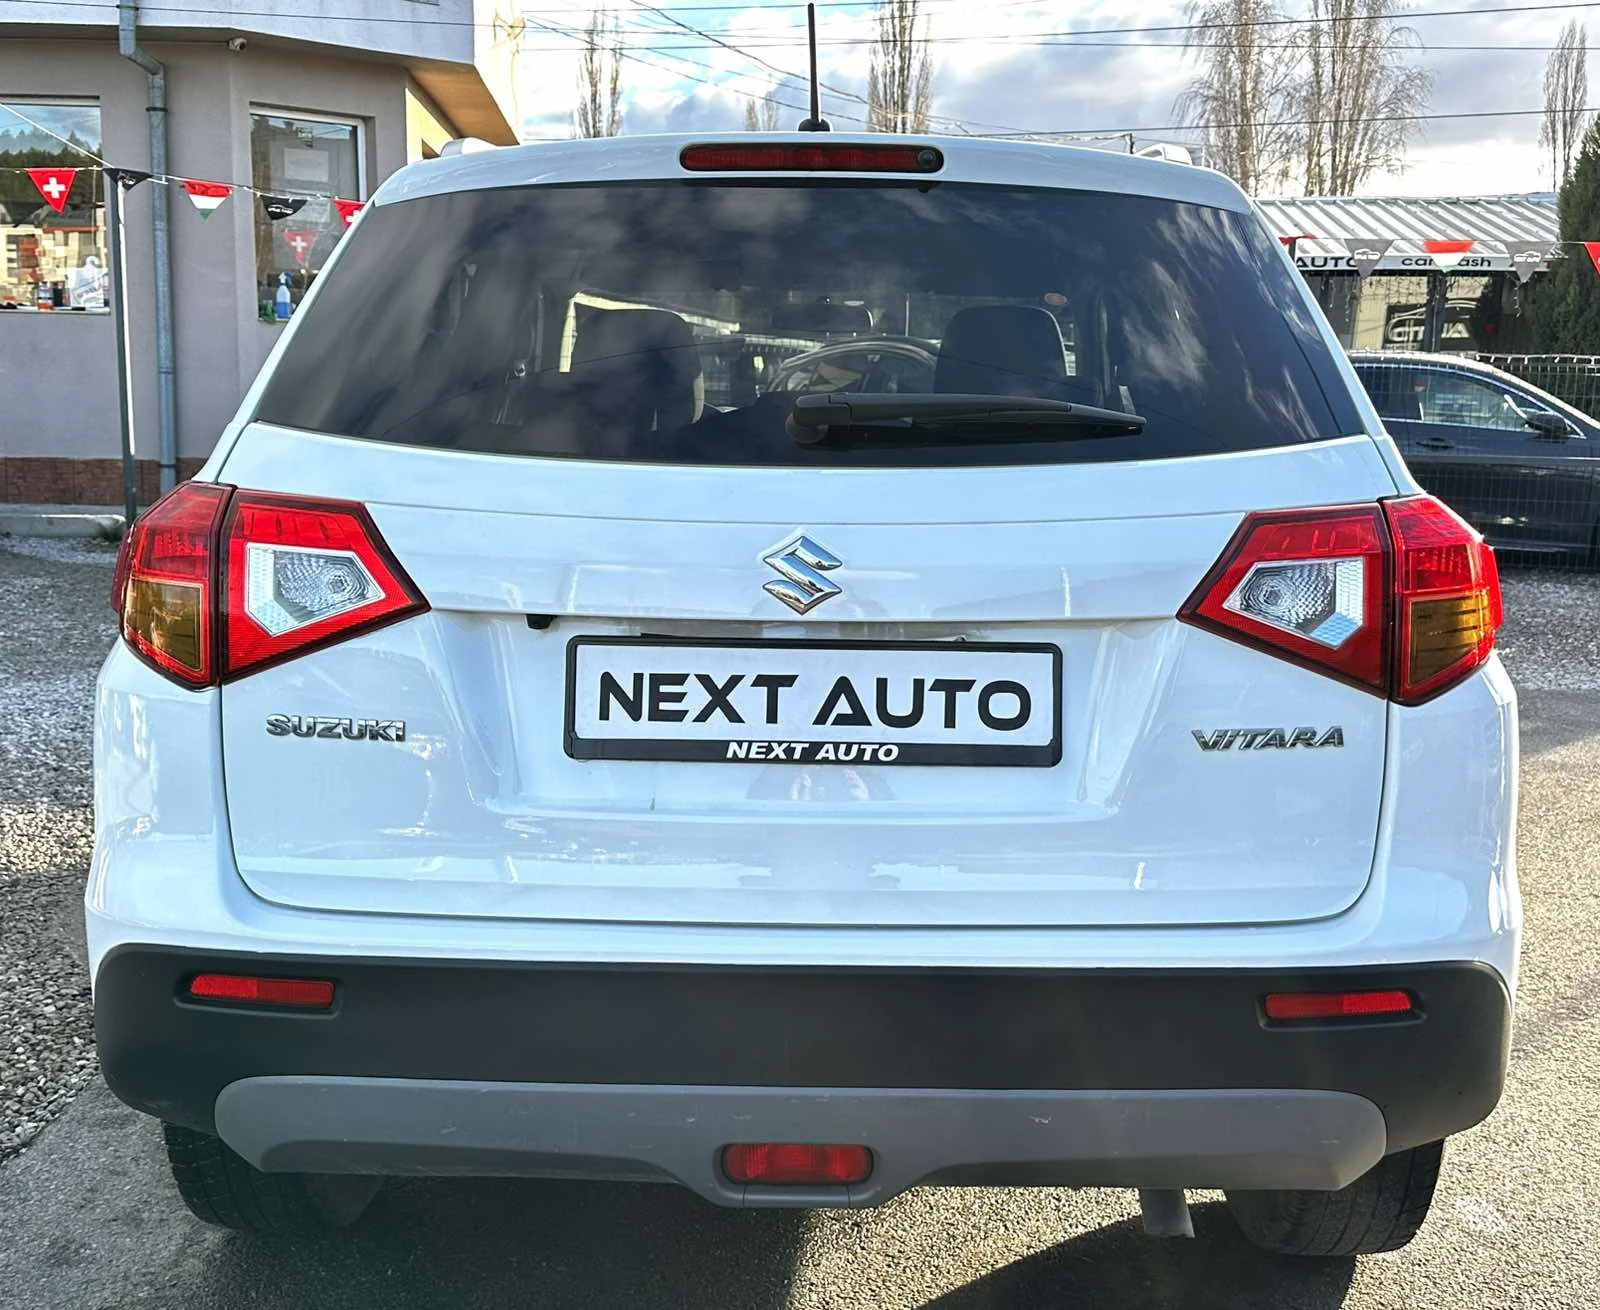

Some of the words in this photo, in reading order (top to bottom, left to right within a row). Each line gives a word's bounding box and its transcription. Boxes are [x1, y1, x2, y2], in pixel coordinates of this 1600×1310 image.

[599, 671, 799, 724] NEXT
[812, 676, 1031, 731] AUTO
[266, 713, 406, 742] SUZUKI
[1191, 725, 1344, 751] VITARA
[726, 742, 809, 759] NEXT
[815, 743, 899, 761] AUTO
